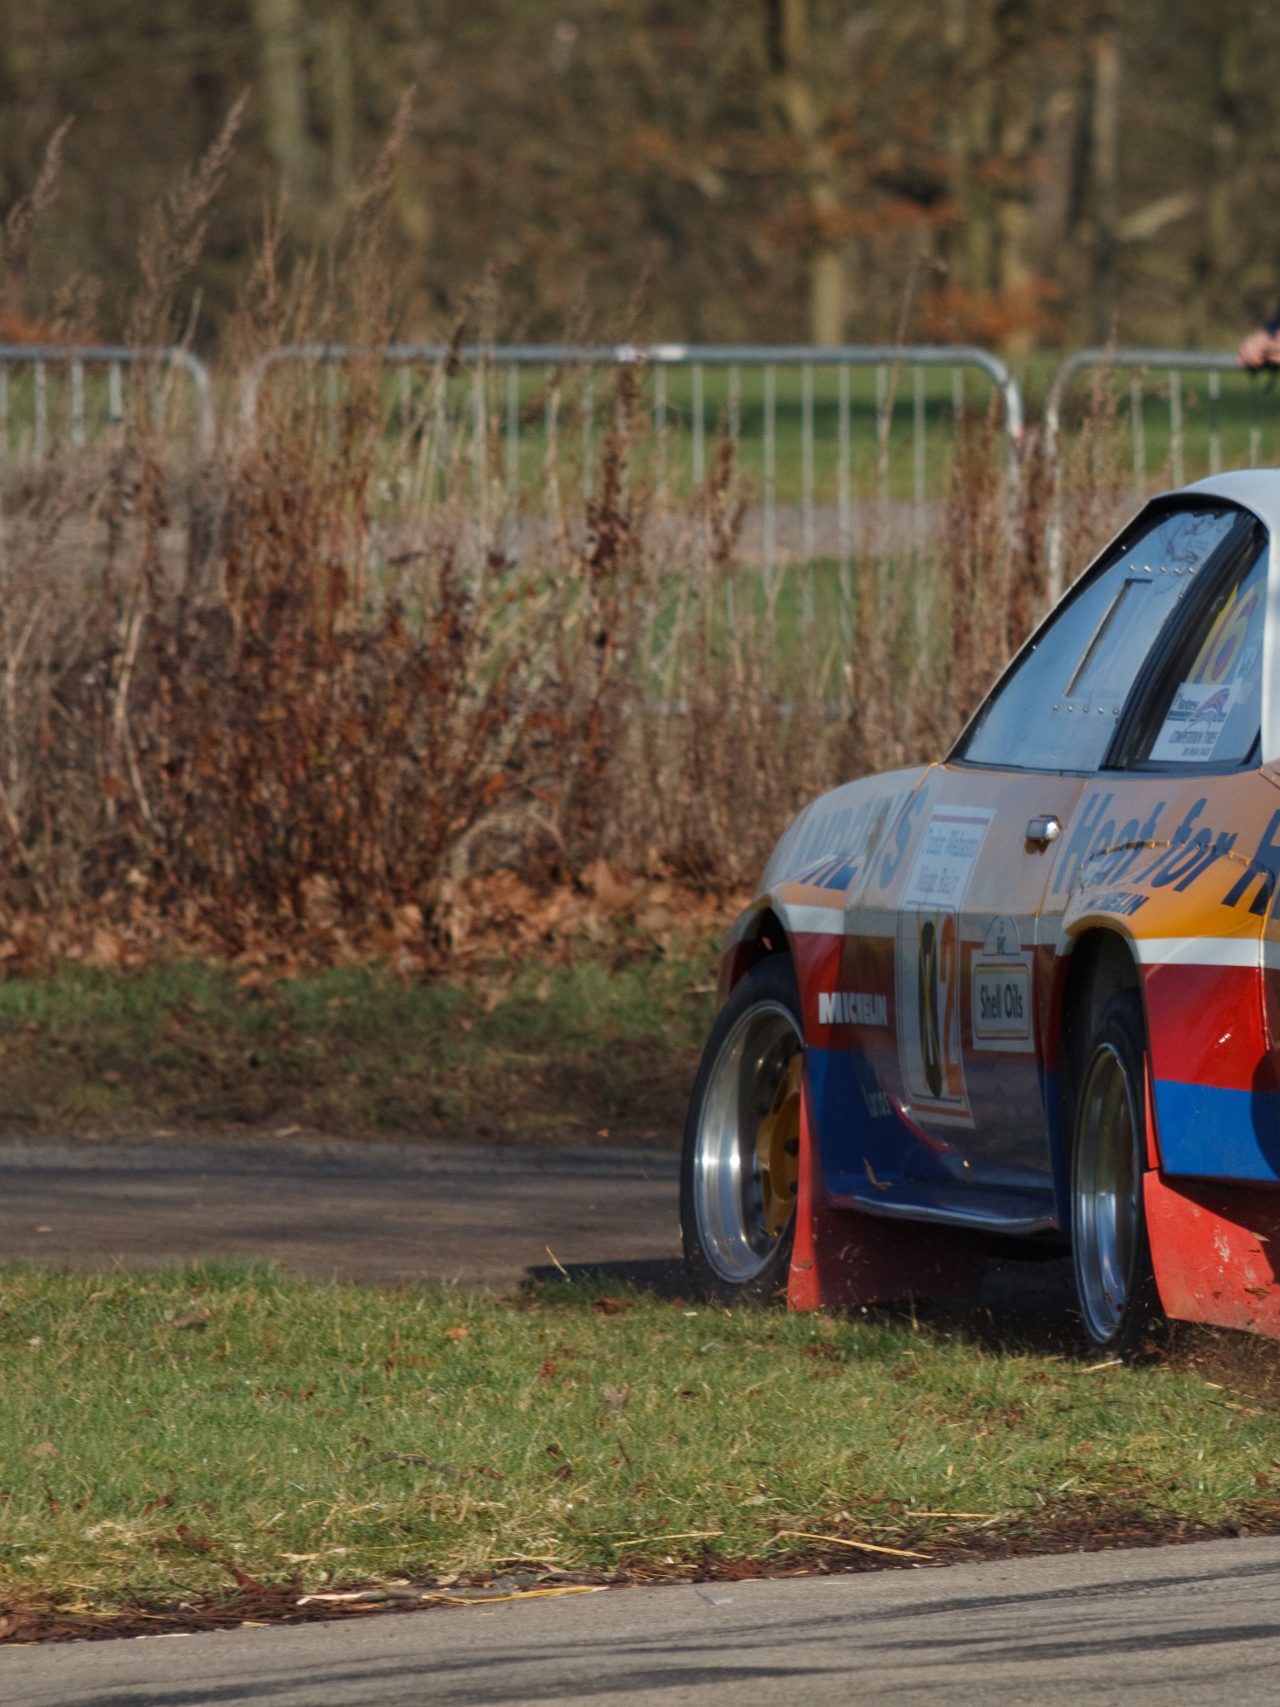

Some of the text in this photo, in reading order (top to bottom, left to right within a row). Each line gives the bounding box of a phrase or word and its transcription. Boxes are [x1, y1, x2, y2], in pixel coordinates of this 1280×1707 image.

[1051, 793, 1166, 894] Heat
[1131, 798, 1238, 892] for
[818, 991, 888, 1027] MICHELIN
[980, 983, 1023, 1020] Shell Oils
